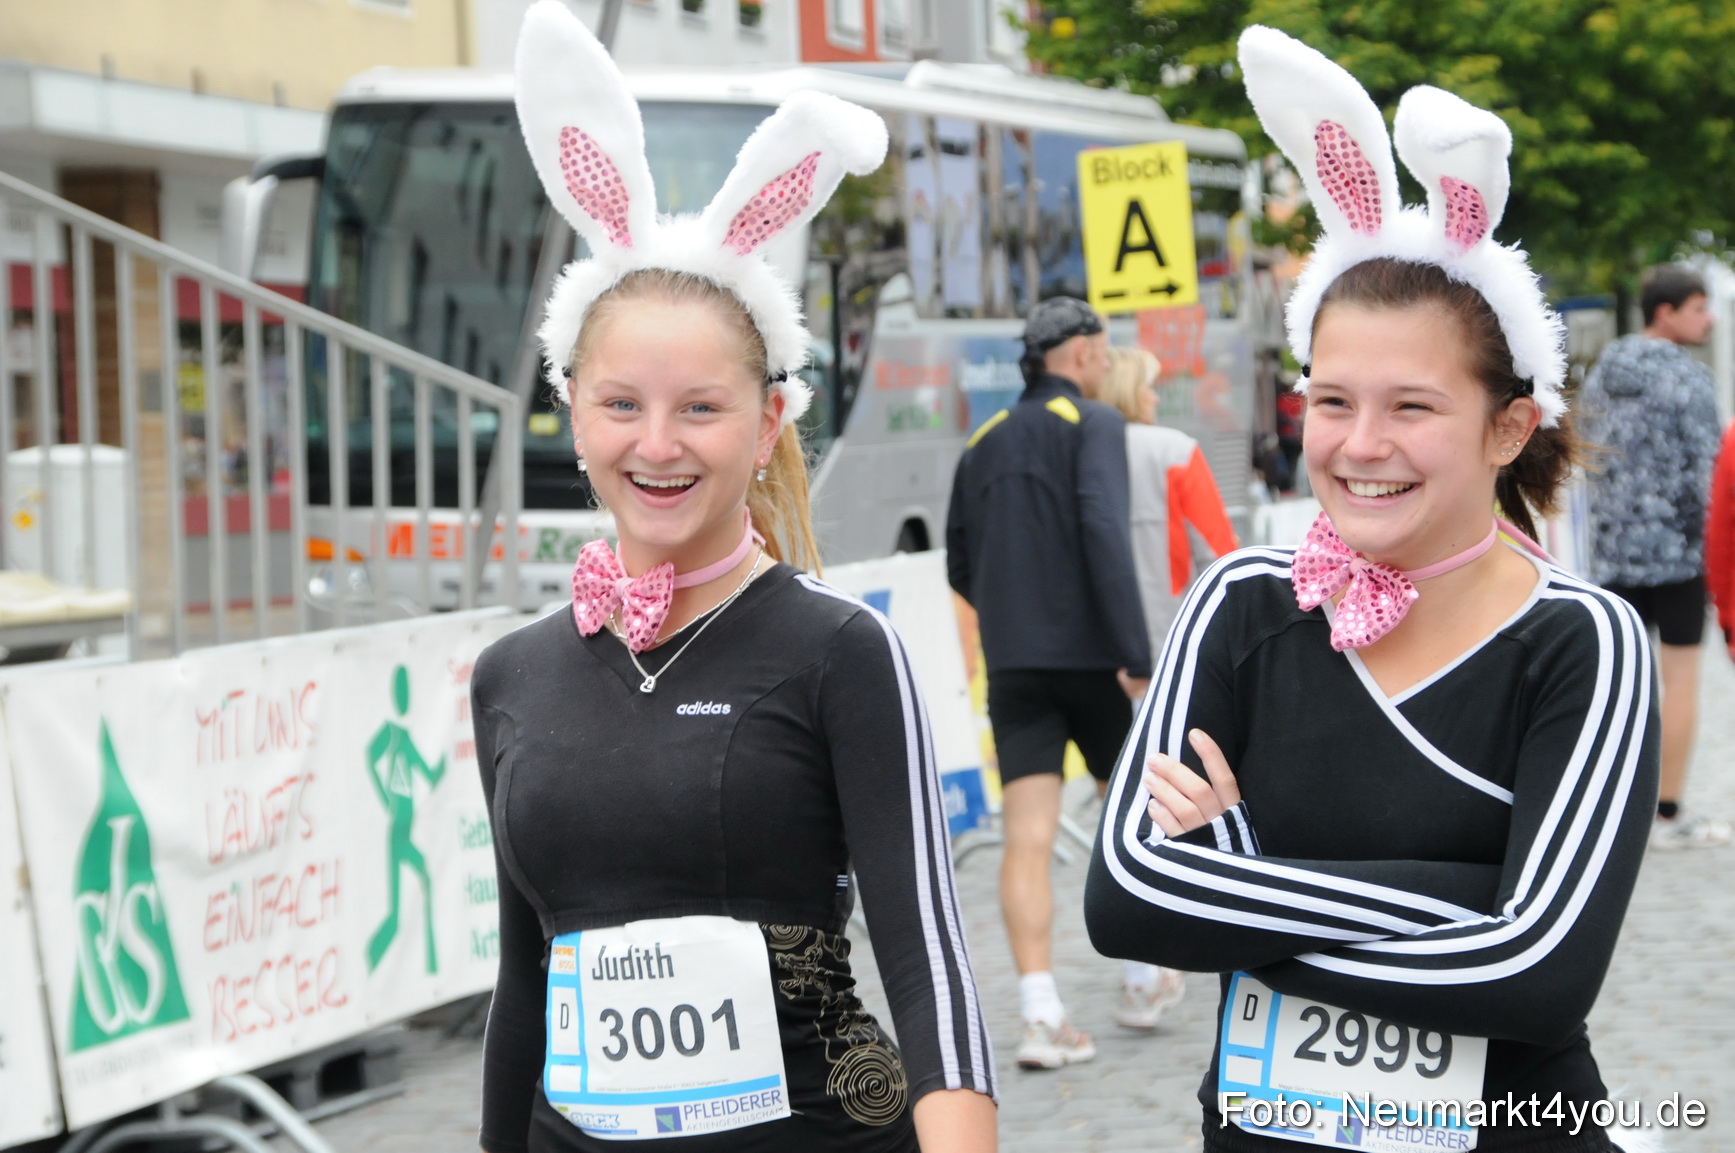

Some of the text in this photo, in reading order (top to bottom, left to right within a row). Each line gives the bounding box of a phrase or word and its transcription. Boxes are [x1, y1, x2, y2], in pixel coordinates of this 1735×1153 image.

[1092, 151, 1174, 184] Block
[1113, 199, 1167, 272] A
[254, 681, 316, 754] UNS
[676, 701, 732, 716] adidas
[591, 943, 675, 981] Judith
[207, 946, 350, 1044] BESSER
[1243, 993, 1259, 1022] D
[559, 1003, 570, 1030] D
[599, 998, 741, 1062] 3001
[1294, 1005, 1454, 1080] 2999
[683, 1089, 783, 1121] PFLEIDERER
[686, 1106, 785, 1132] AKTIENGESELLSCHAFT
[1366, 1120, 1470, 1150] PFLEIDERER
